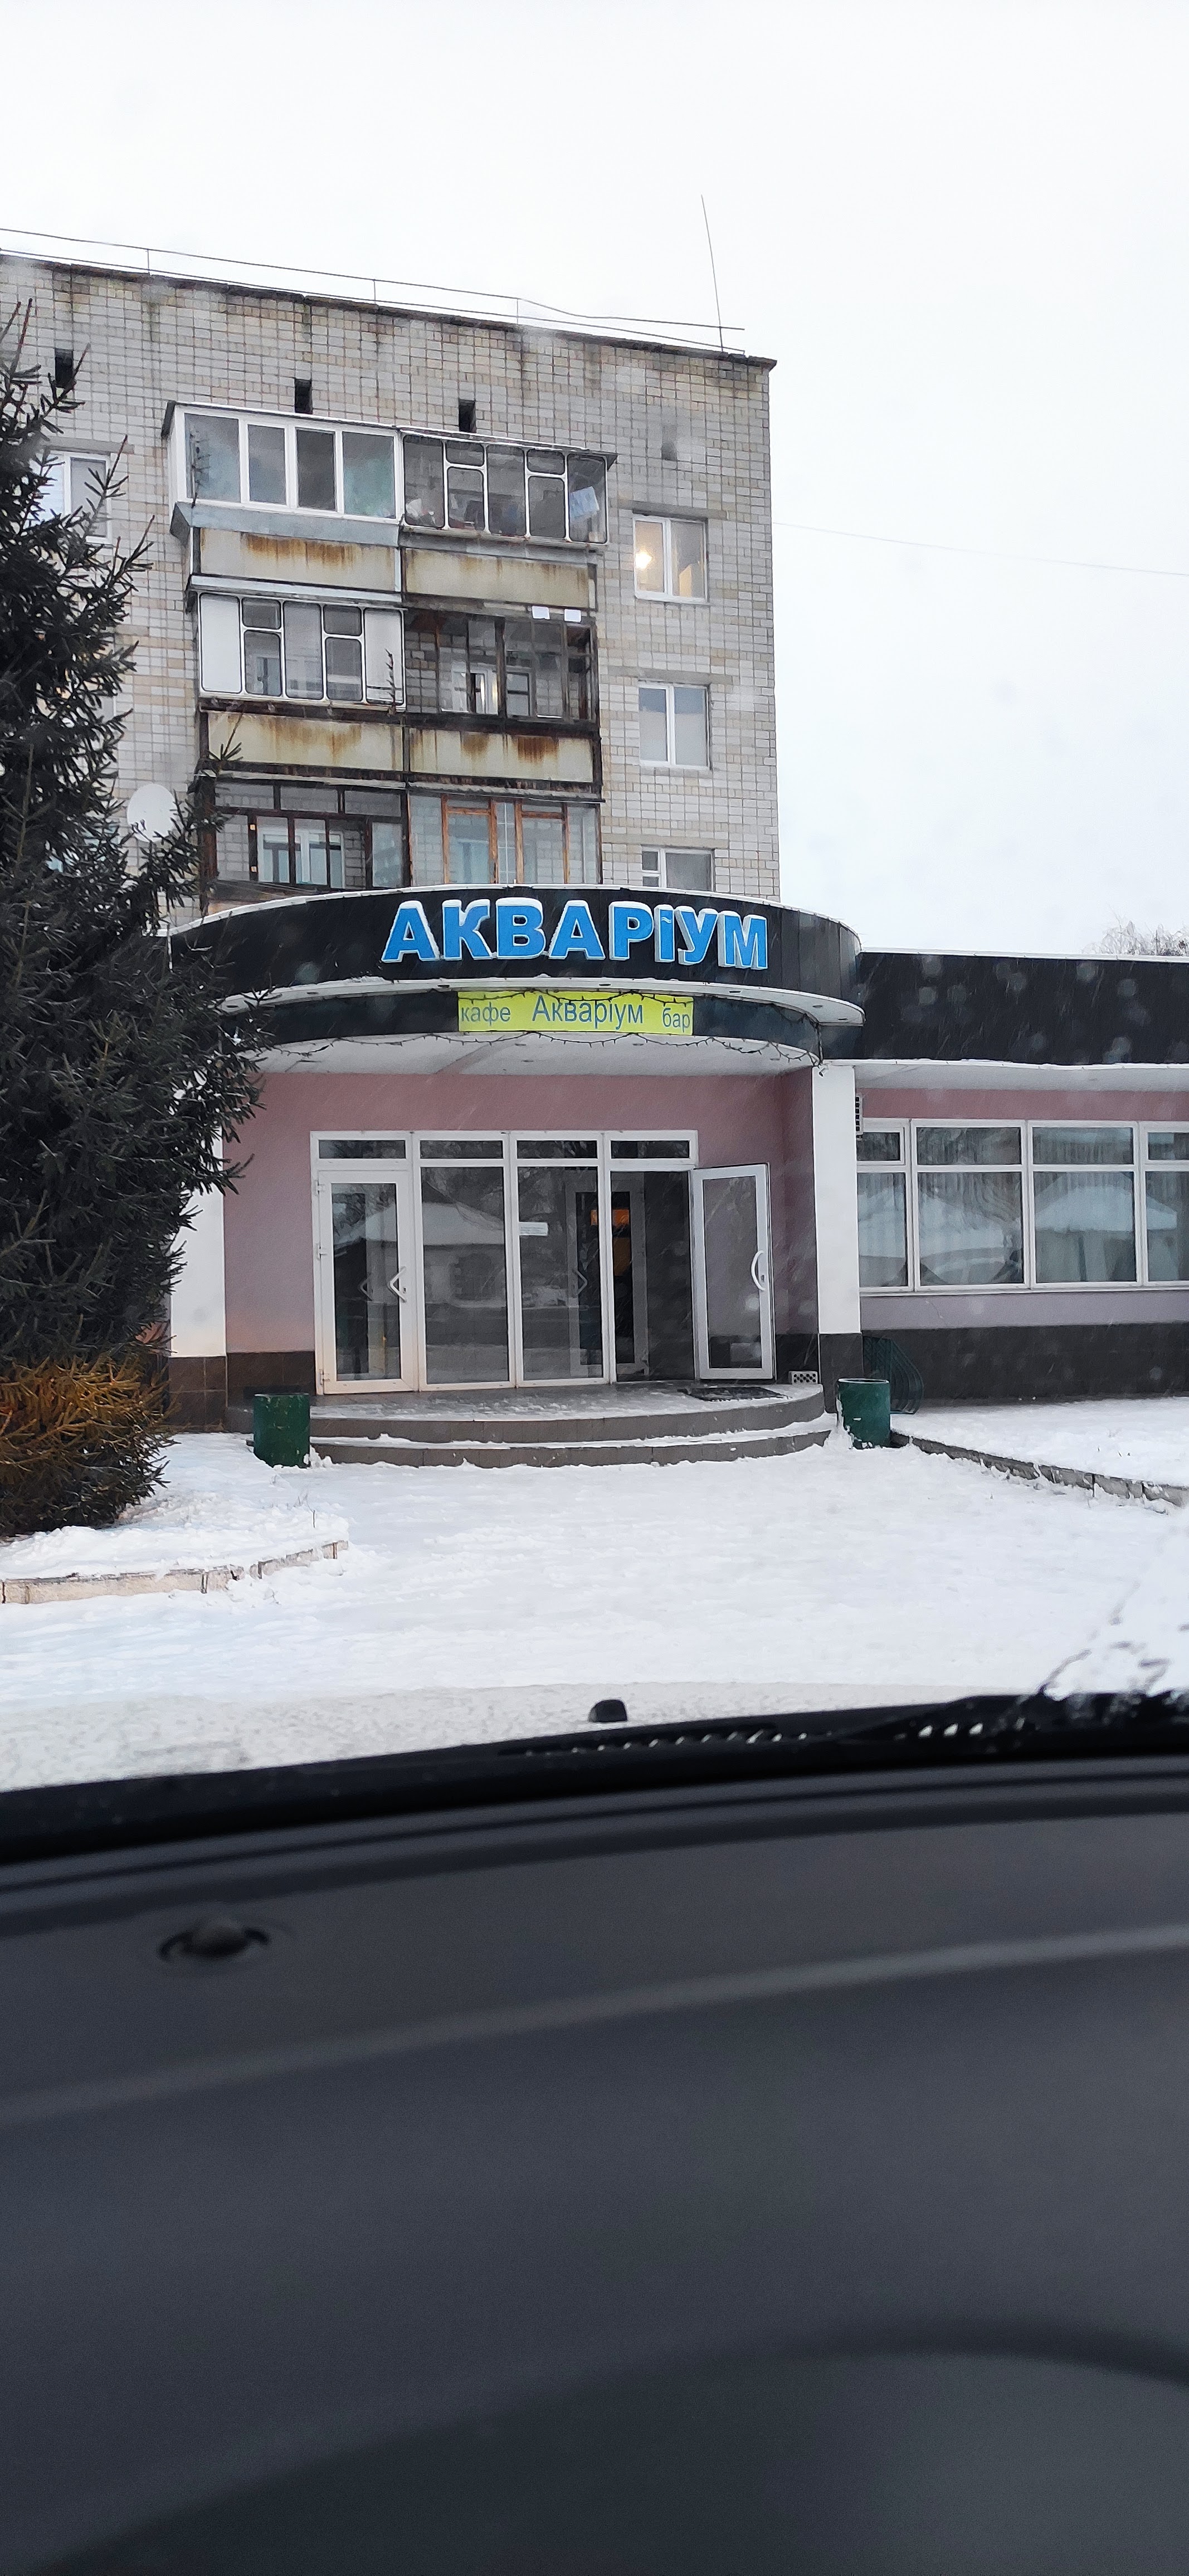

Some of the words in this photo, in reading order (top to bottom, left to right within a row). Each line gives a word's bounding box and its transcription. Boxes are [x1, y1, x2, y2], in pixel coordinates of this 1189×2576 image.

[461, 1002, 511, 1026] кафе
[532, 995, 643, 1030] Акваріум
[662, 1007, 691, 1033] бар
